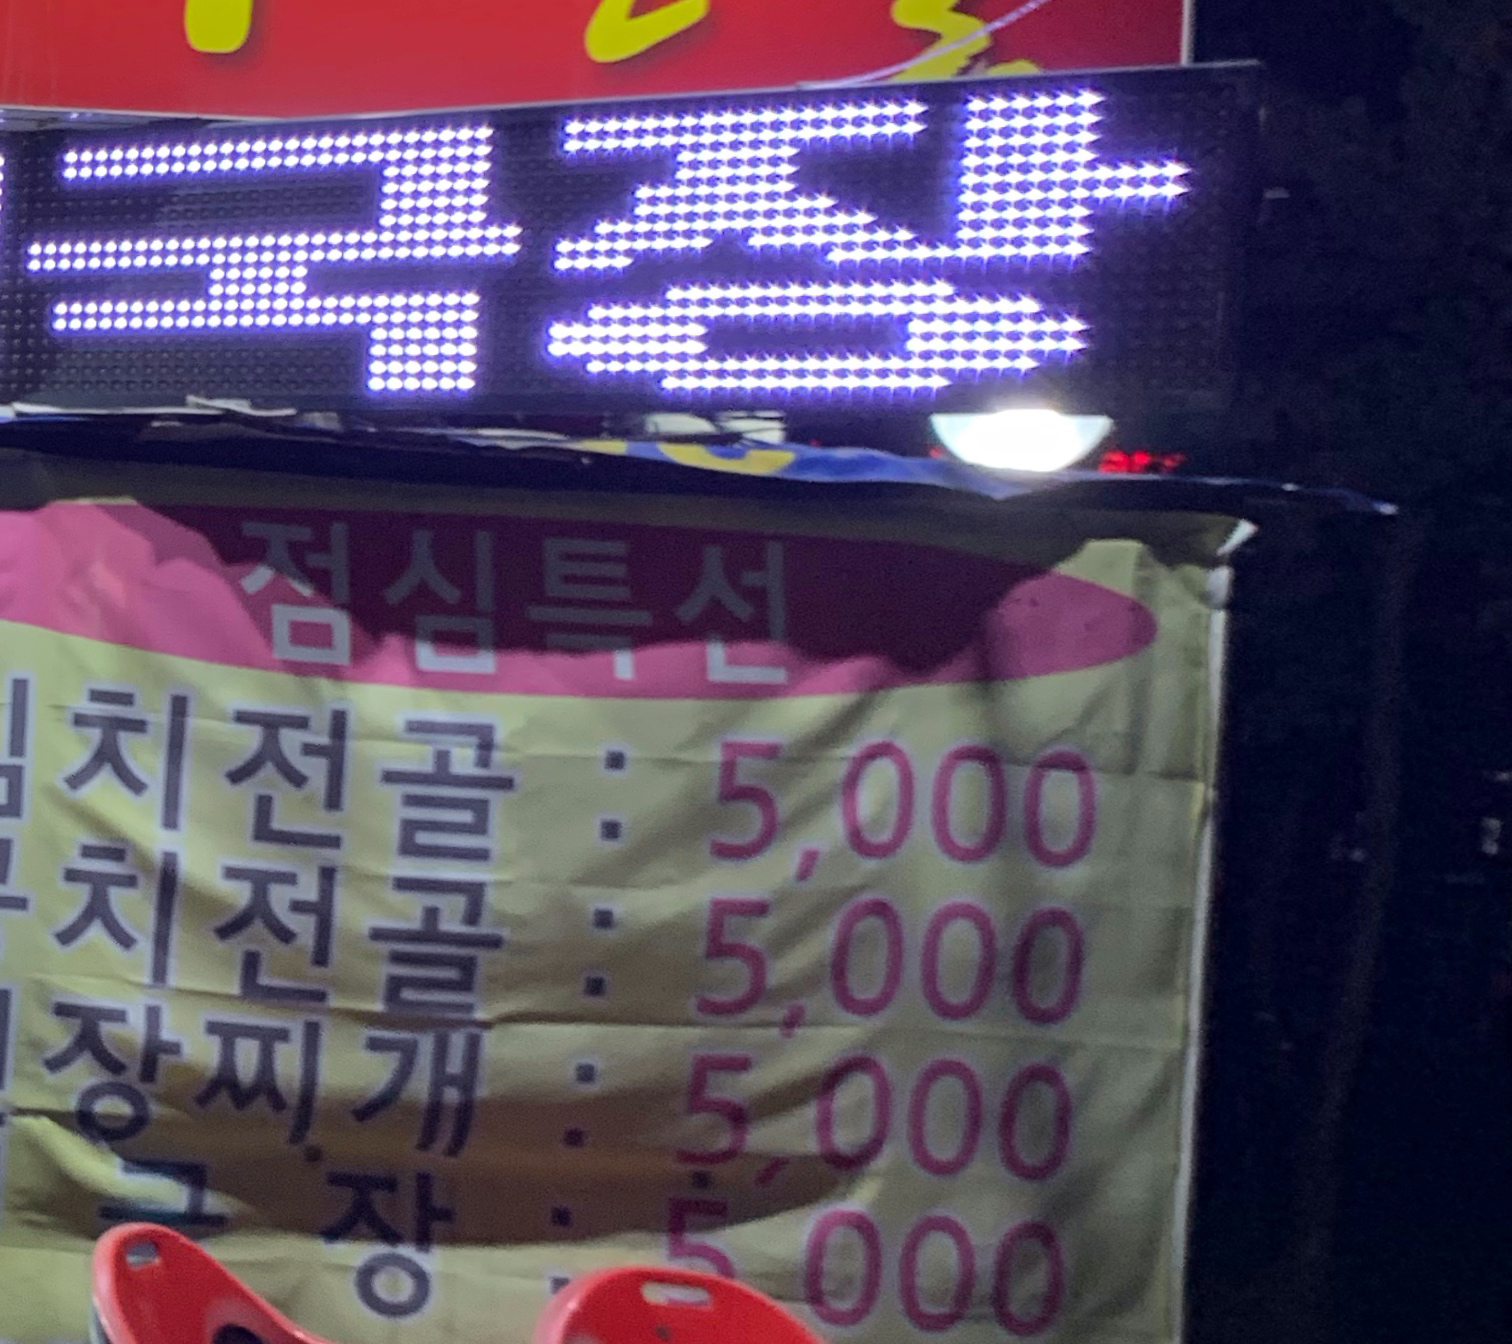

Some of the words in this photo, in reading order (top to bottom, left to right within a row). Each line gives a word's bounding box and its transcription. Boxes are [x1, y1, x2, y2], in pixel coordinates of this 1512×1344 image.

[241, 520, 788, 684] 점심특선
[709, 740, 1097, 882] 5,000
[695, 897, 1084, 1038] 5,000
[675, 1054, 1074, 1187] 5,000
